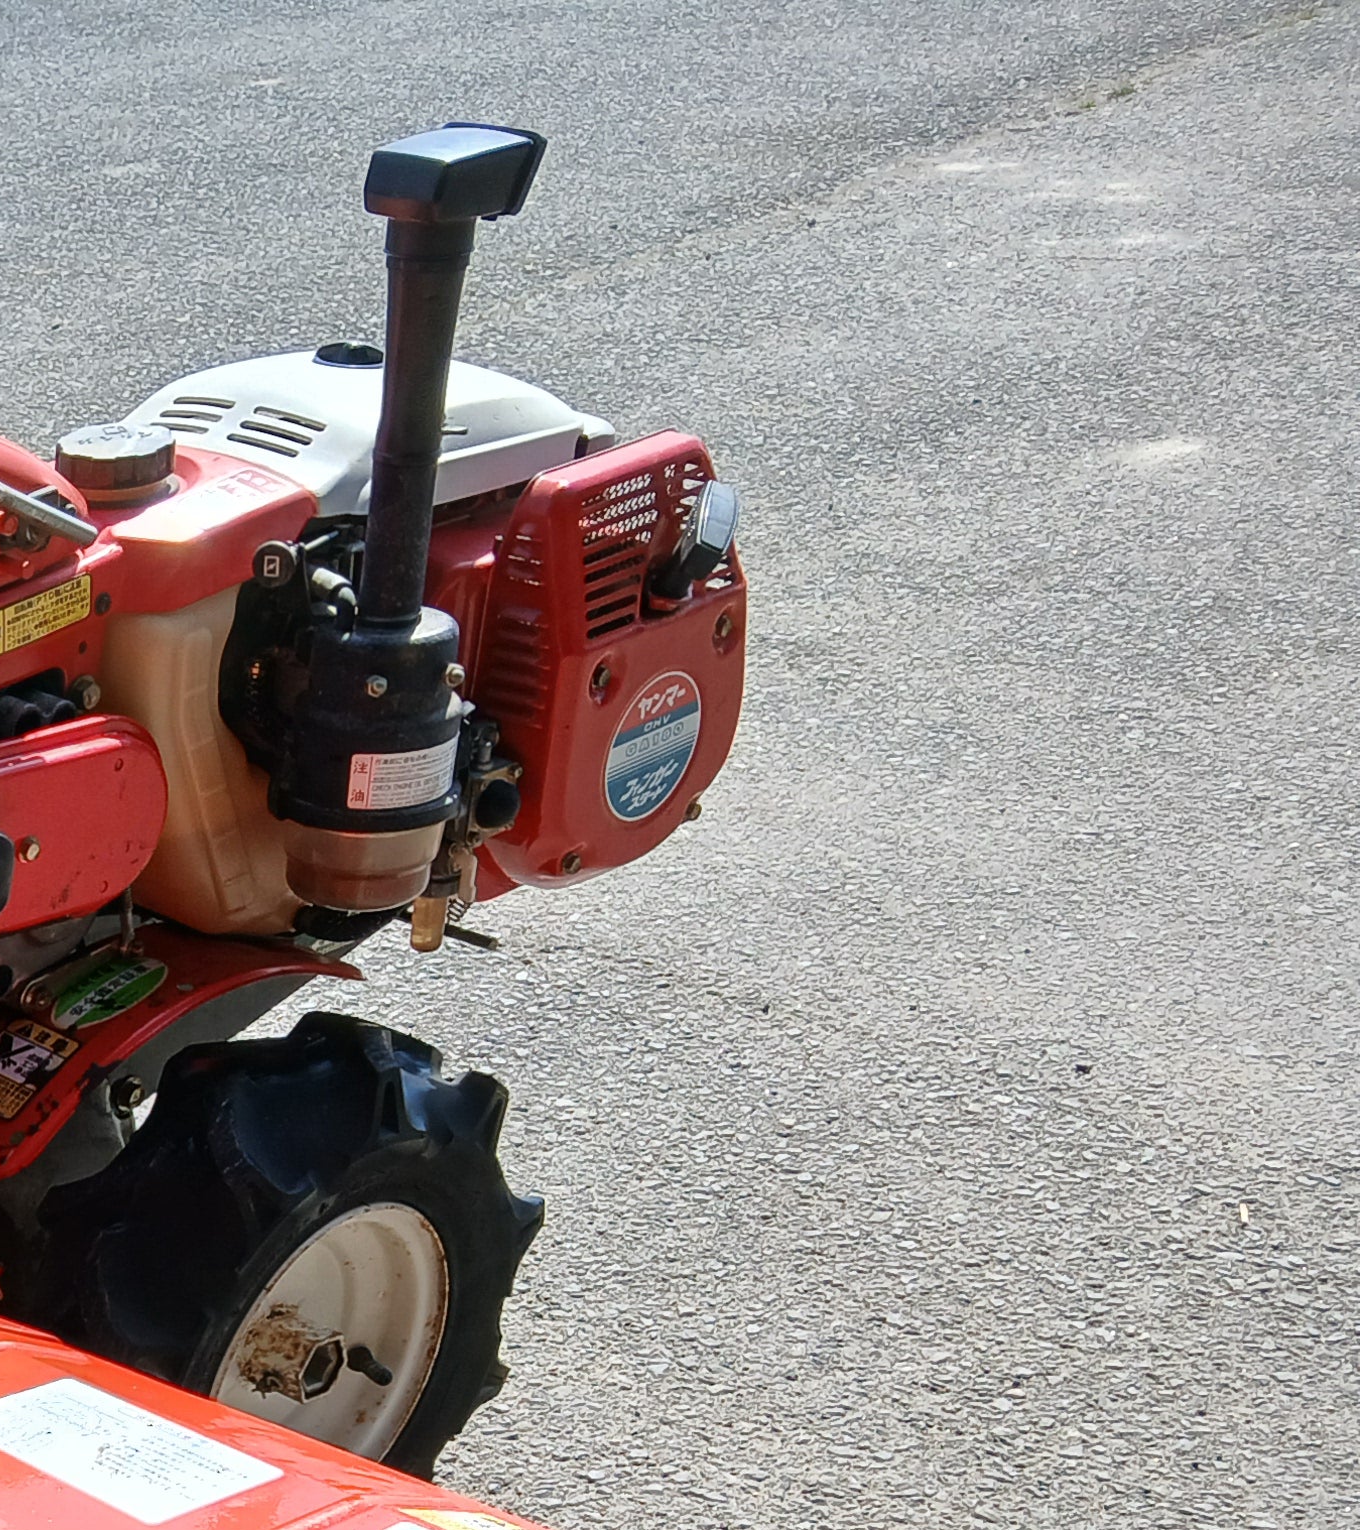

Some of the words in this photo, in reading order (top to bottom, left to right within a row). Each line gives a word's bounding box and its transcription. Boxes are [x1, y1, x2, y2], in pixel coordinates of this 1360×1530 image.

[638, 684, 686, 720] ヤンマー
[643, 714, 671, 732] OHV
